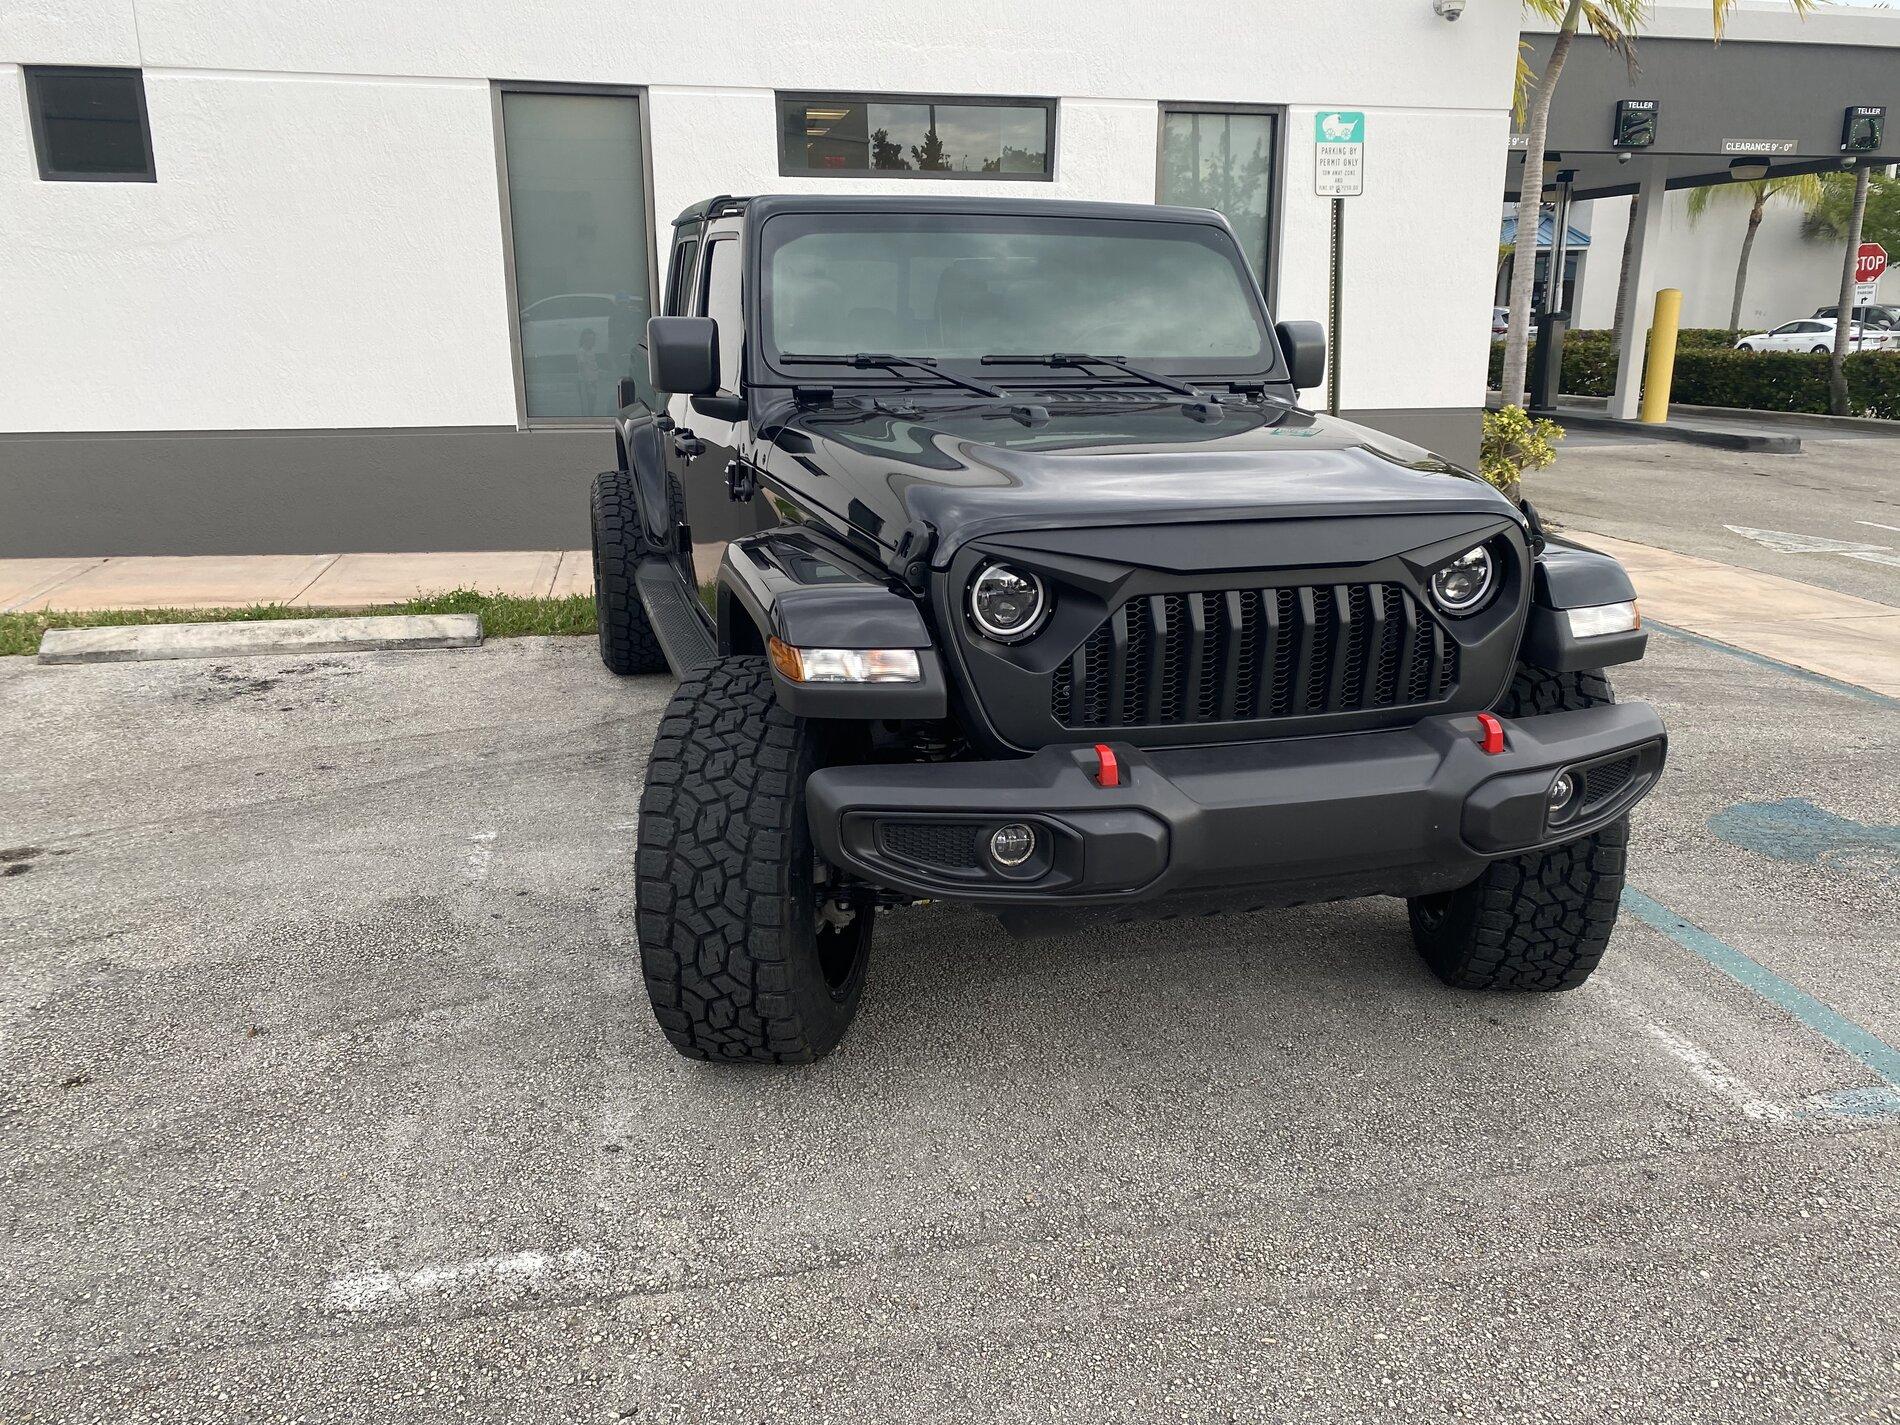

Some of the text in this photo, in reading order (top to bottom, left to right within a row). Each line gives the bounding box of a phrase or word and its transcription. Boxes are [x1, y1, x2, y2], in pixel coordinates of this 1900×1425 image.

[1628, 101, 1654, 109] TELLER
[1857, 107, 1881, 115] TELLER
[1725, 142, 1771, 151] CLEARANCE
[1321, 147, 1358, 155] PARKING BY
[1320, 158, 1359, 167] PERMIT ONLY
